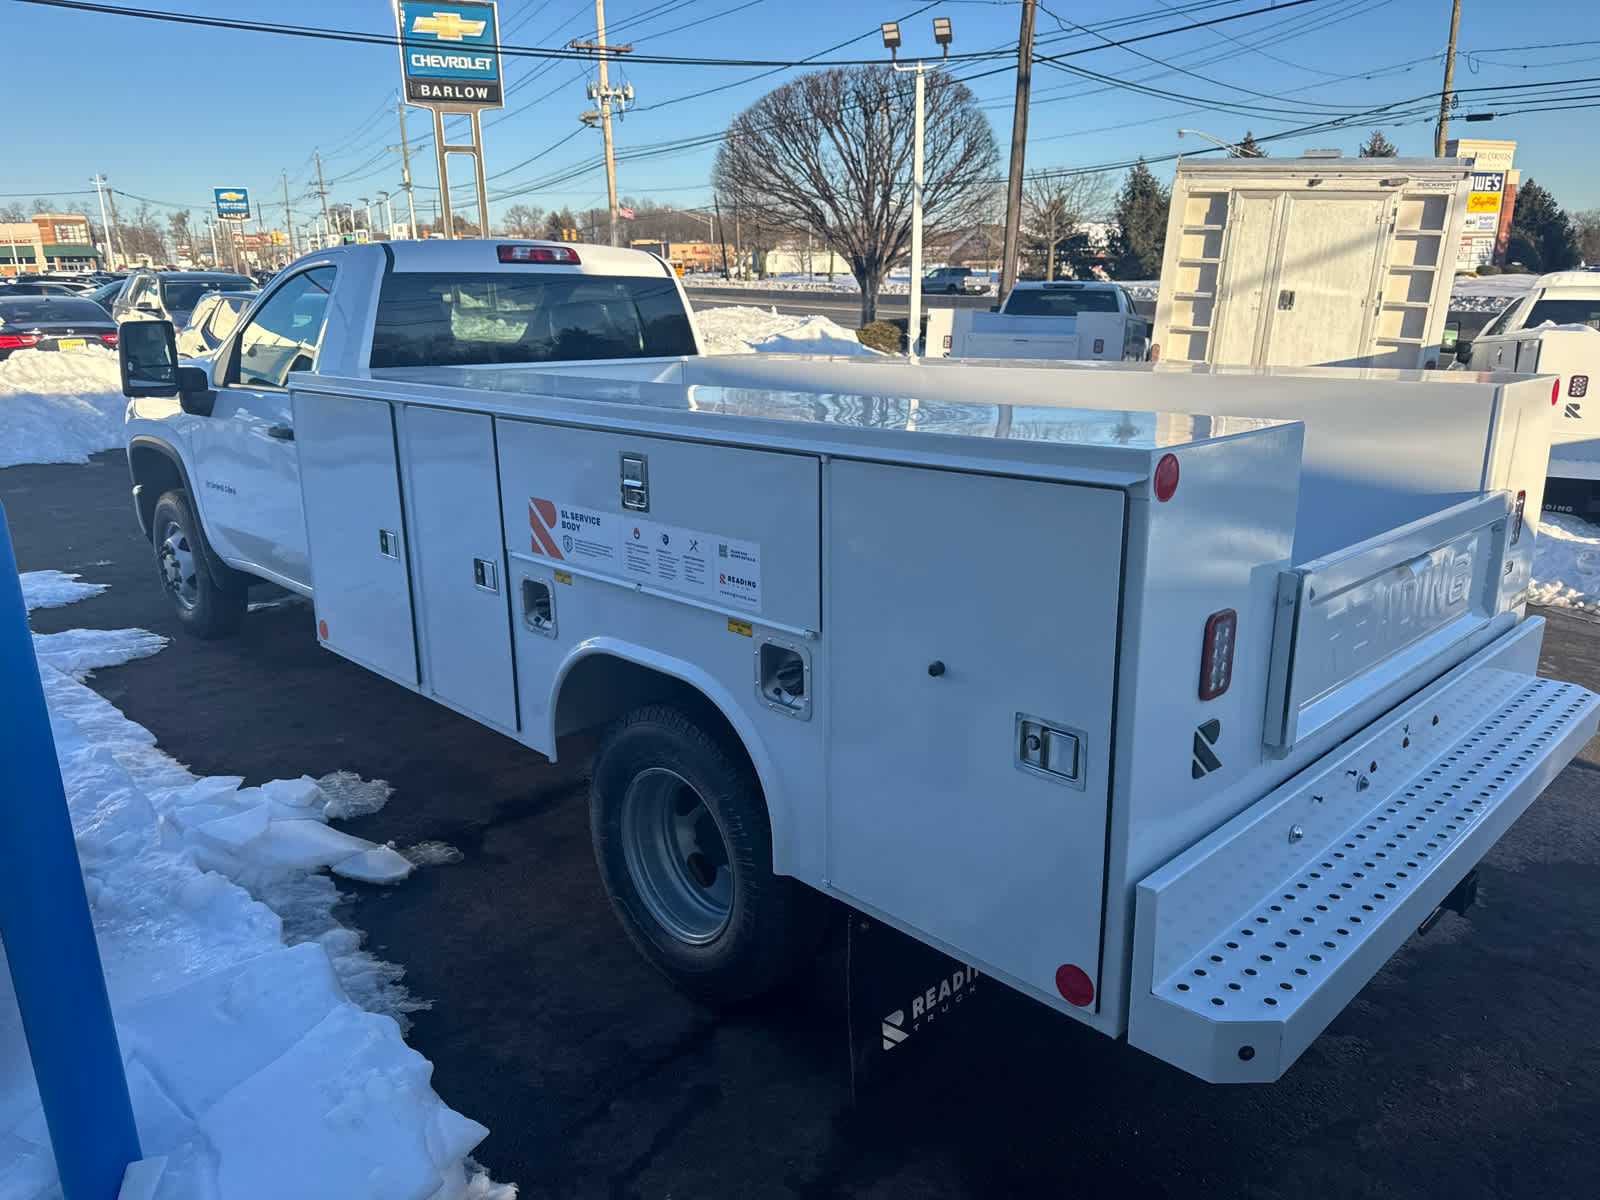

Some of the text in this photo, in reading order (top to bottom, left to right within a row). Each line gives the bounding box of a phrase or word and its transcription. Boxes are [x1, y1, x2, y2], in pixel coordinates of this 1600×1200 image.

[411, 54, 492, 70] CHEVROLET
[420, 84, 488, 98] BARLOW
[561, 520, 581, 531] BODY
[570, 512, 601, 527] SERVICE
[727, 575, 757, 589] READING
[912, 984, 976, 1032] TRUCK
